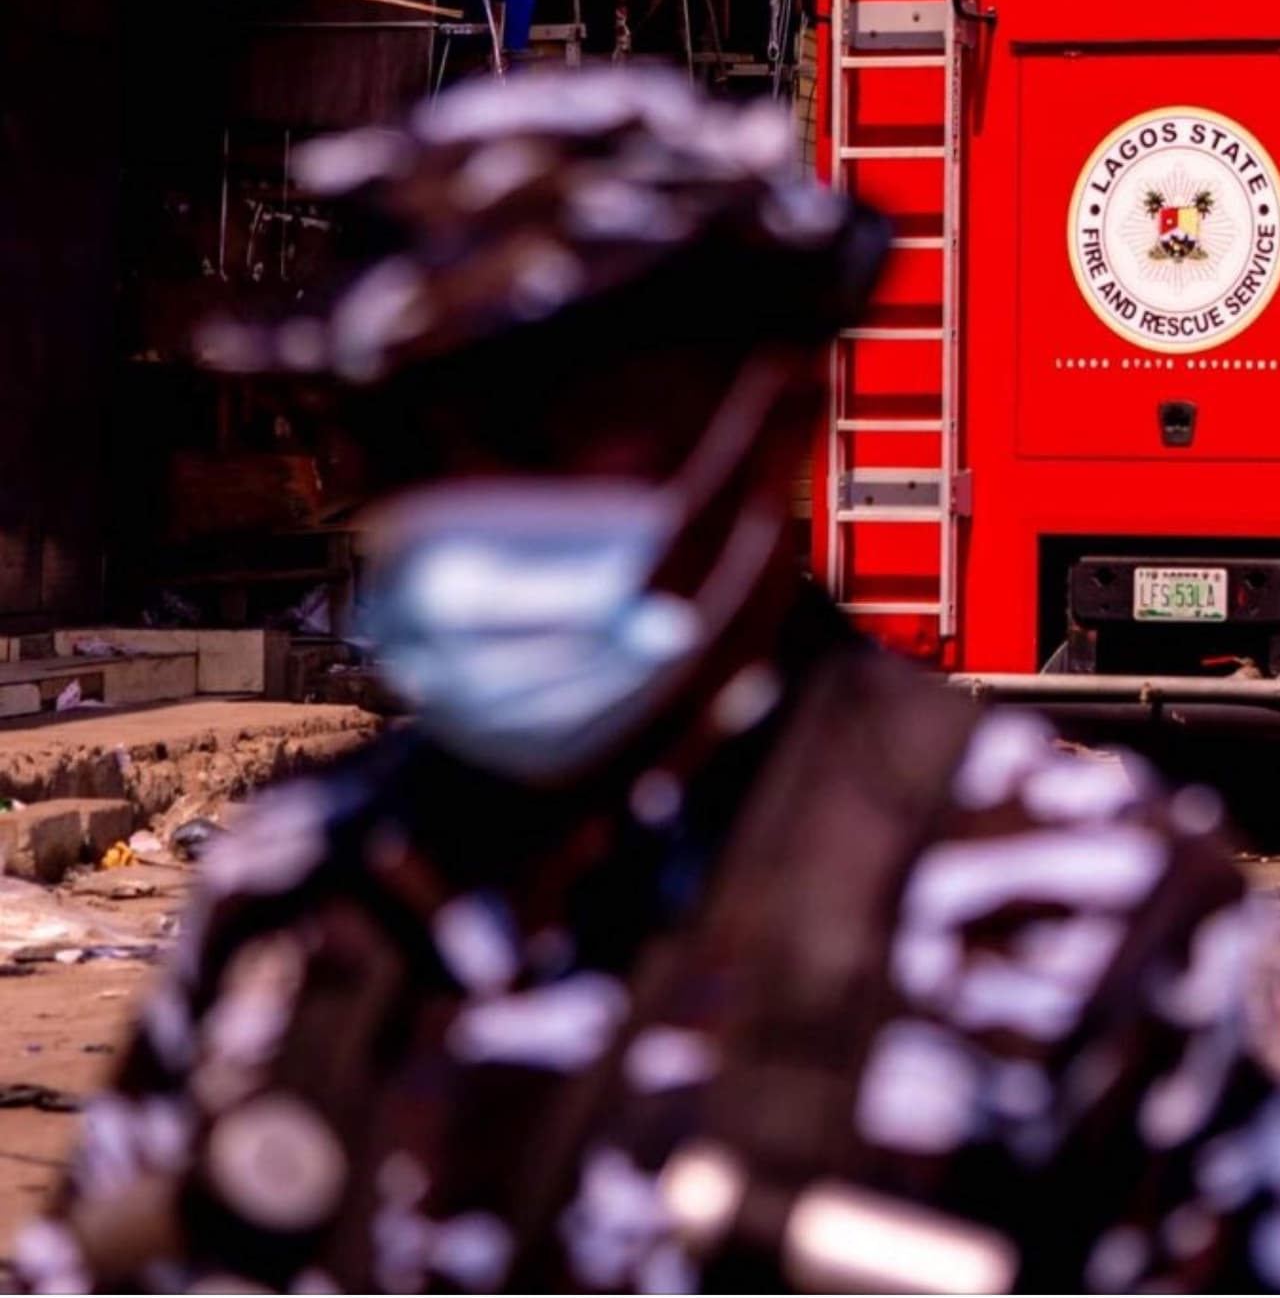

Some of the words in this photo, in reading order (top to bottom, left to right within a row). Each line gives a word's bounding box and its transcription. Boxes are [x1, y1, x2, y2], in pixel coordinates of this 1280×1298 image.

[1091, 122, 1178, 195] LAGOS
[1189, 123, 1268, 195] STATE
[1082, 227, 1109, 280] FIRE
[1098, 282, 1138, 322] AND
[1138, 306, 1225, 337] RESCUE
[1224, 223, 1276, 317] SERVICE
